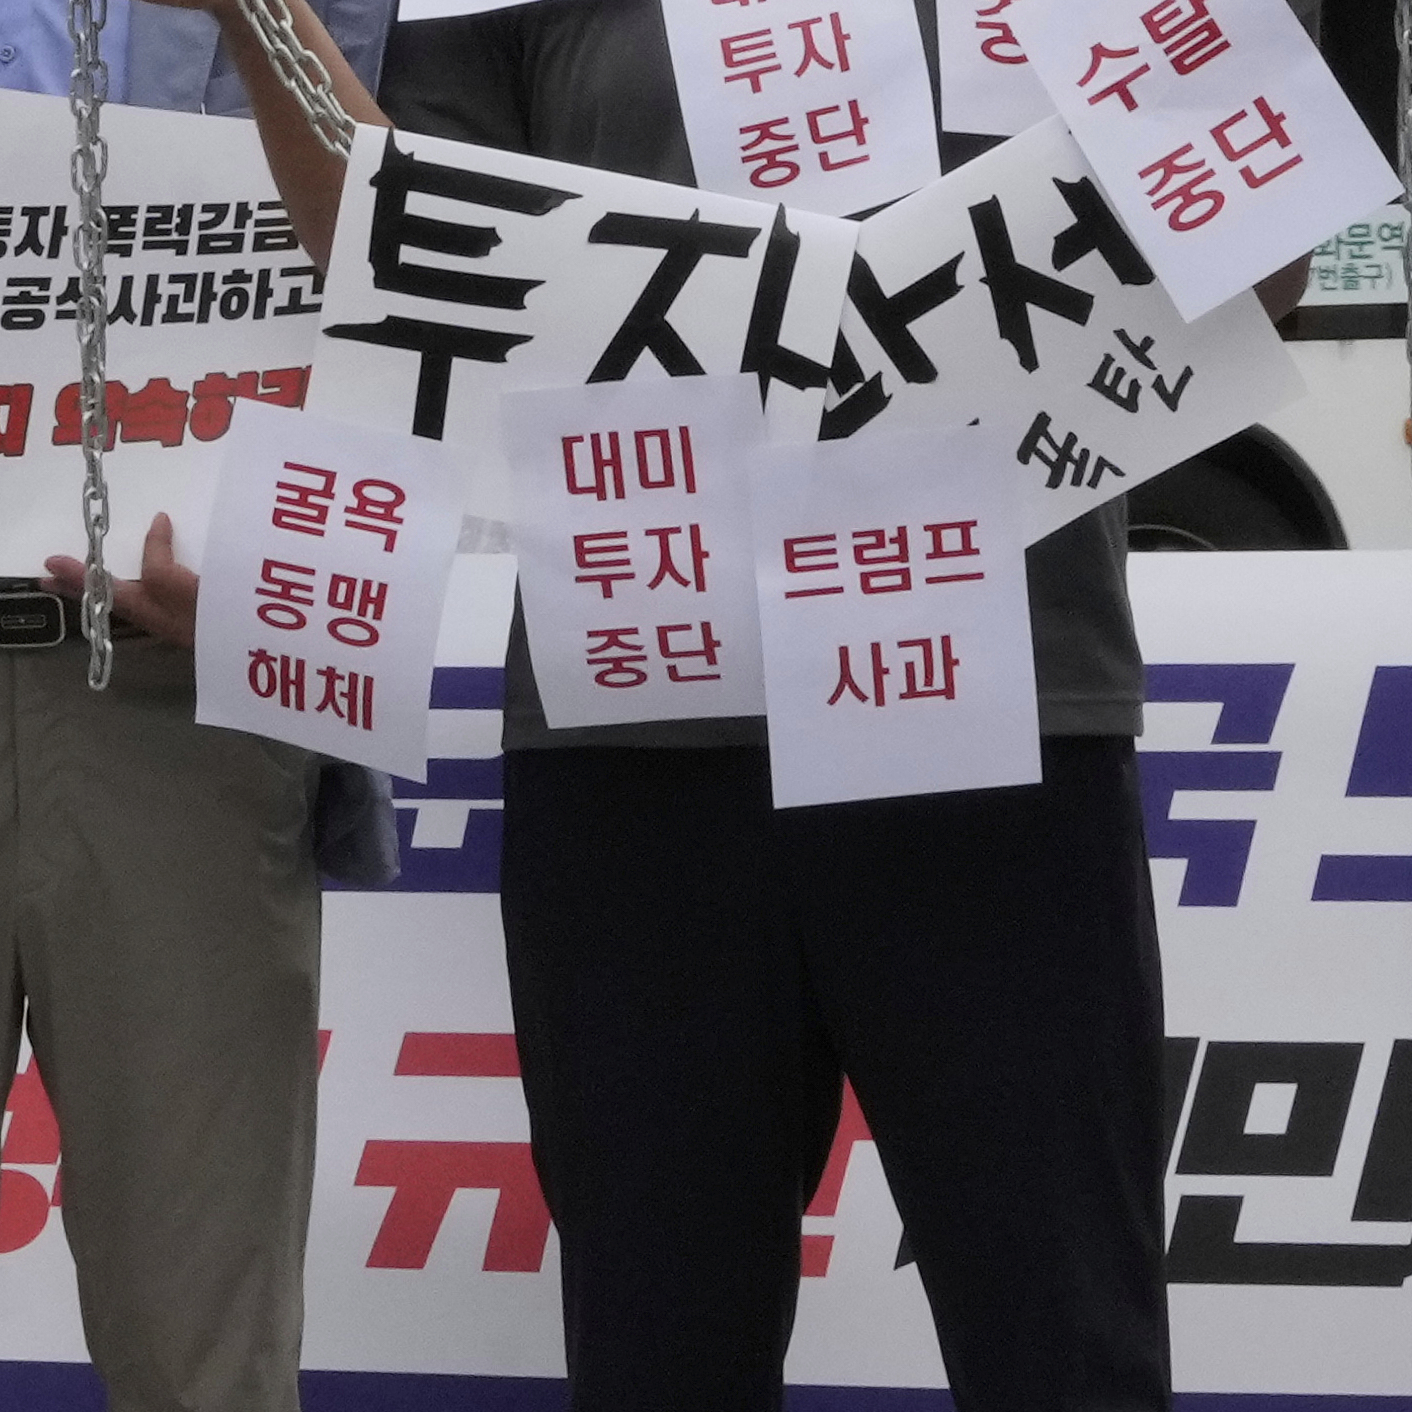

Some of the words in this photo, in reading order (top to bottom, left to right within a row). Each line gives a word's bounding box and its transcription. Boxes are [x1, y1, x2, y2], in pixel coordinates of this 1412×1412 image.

[721, 13, 850, 93] 투자
[740, 100, 869, 188] 중단
[1139, 97, 1302, 231] 중단
[108, 266, 323, 327] 사과하고
[564, 427, 697, 501] 대미
[272, 462, 406, 552] 굴욕
[575, 524, 710, 598] 투자
[784, 521, 984, 598] 트럼프
[257, 560, 388, 647] 동맹
[249, 650, 374, 729] 해체
[588, 622, 720, 688] 중단
[830, 635, 960, 706] 사과
